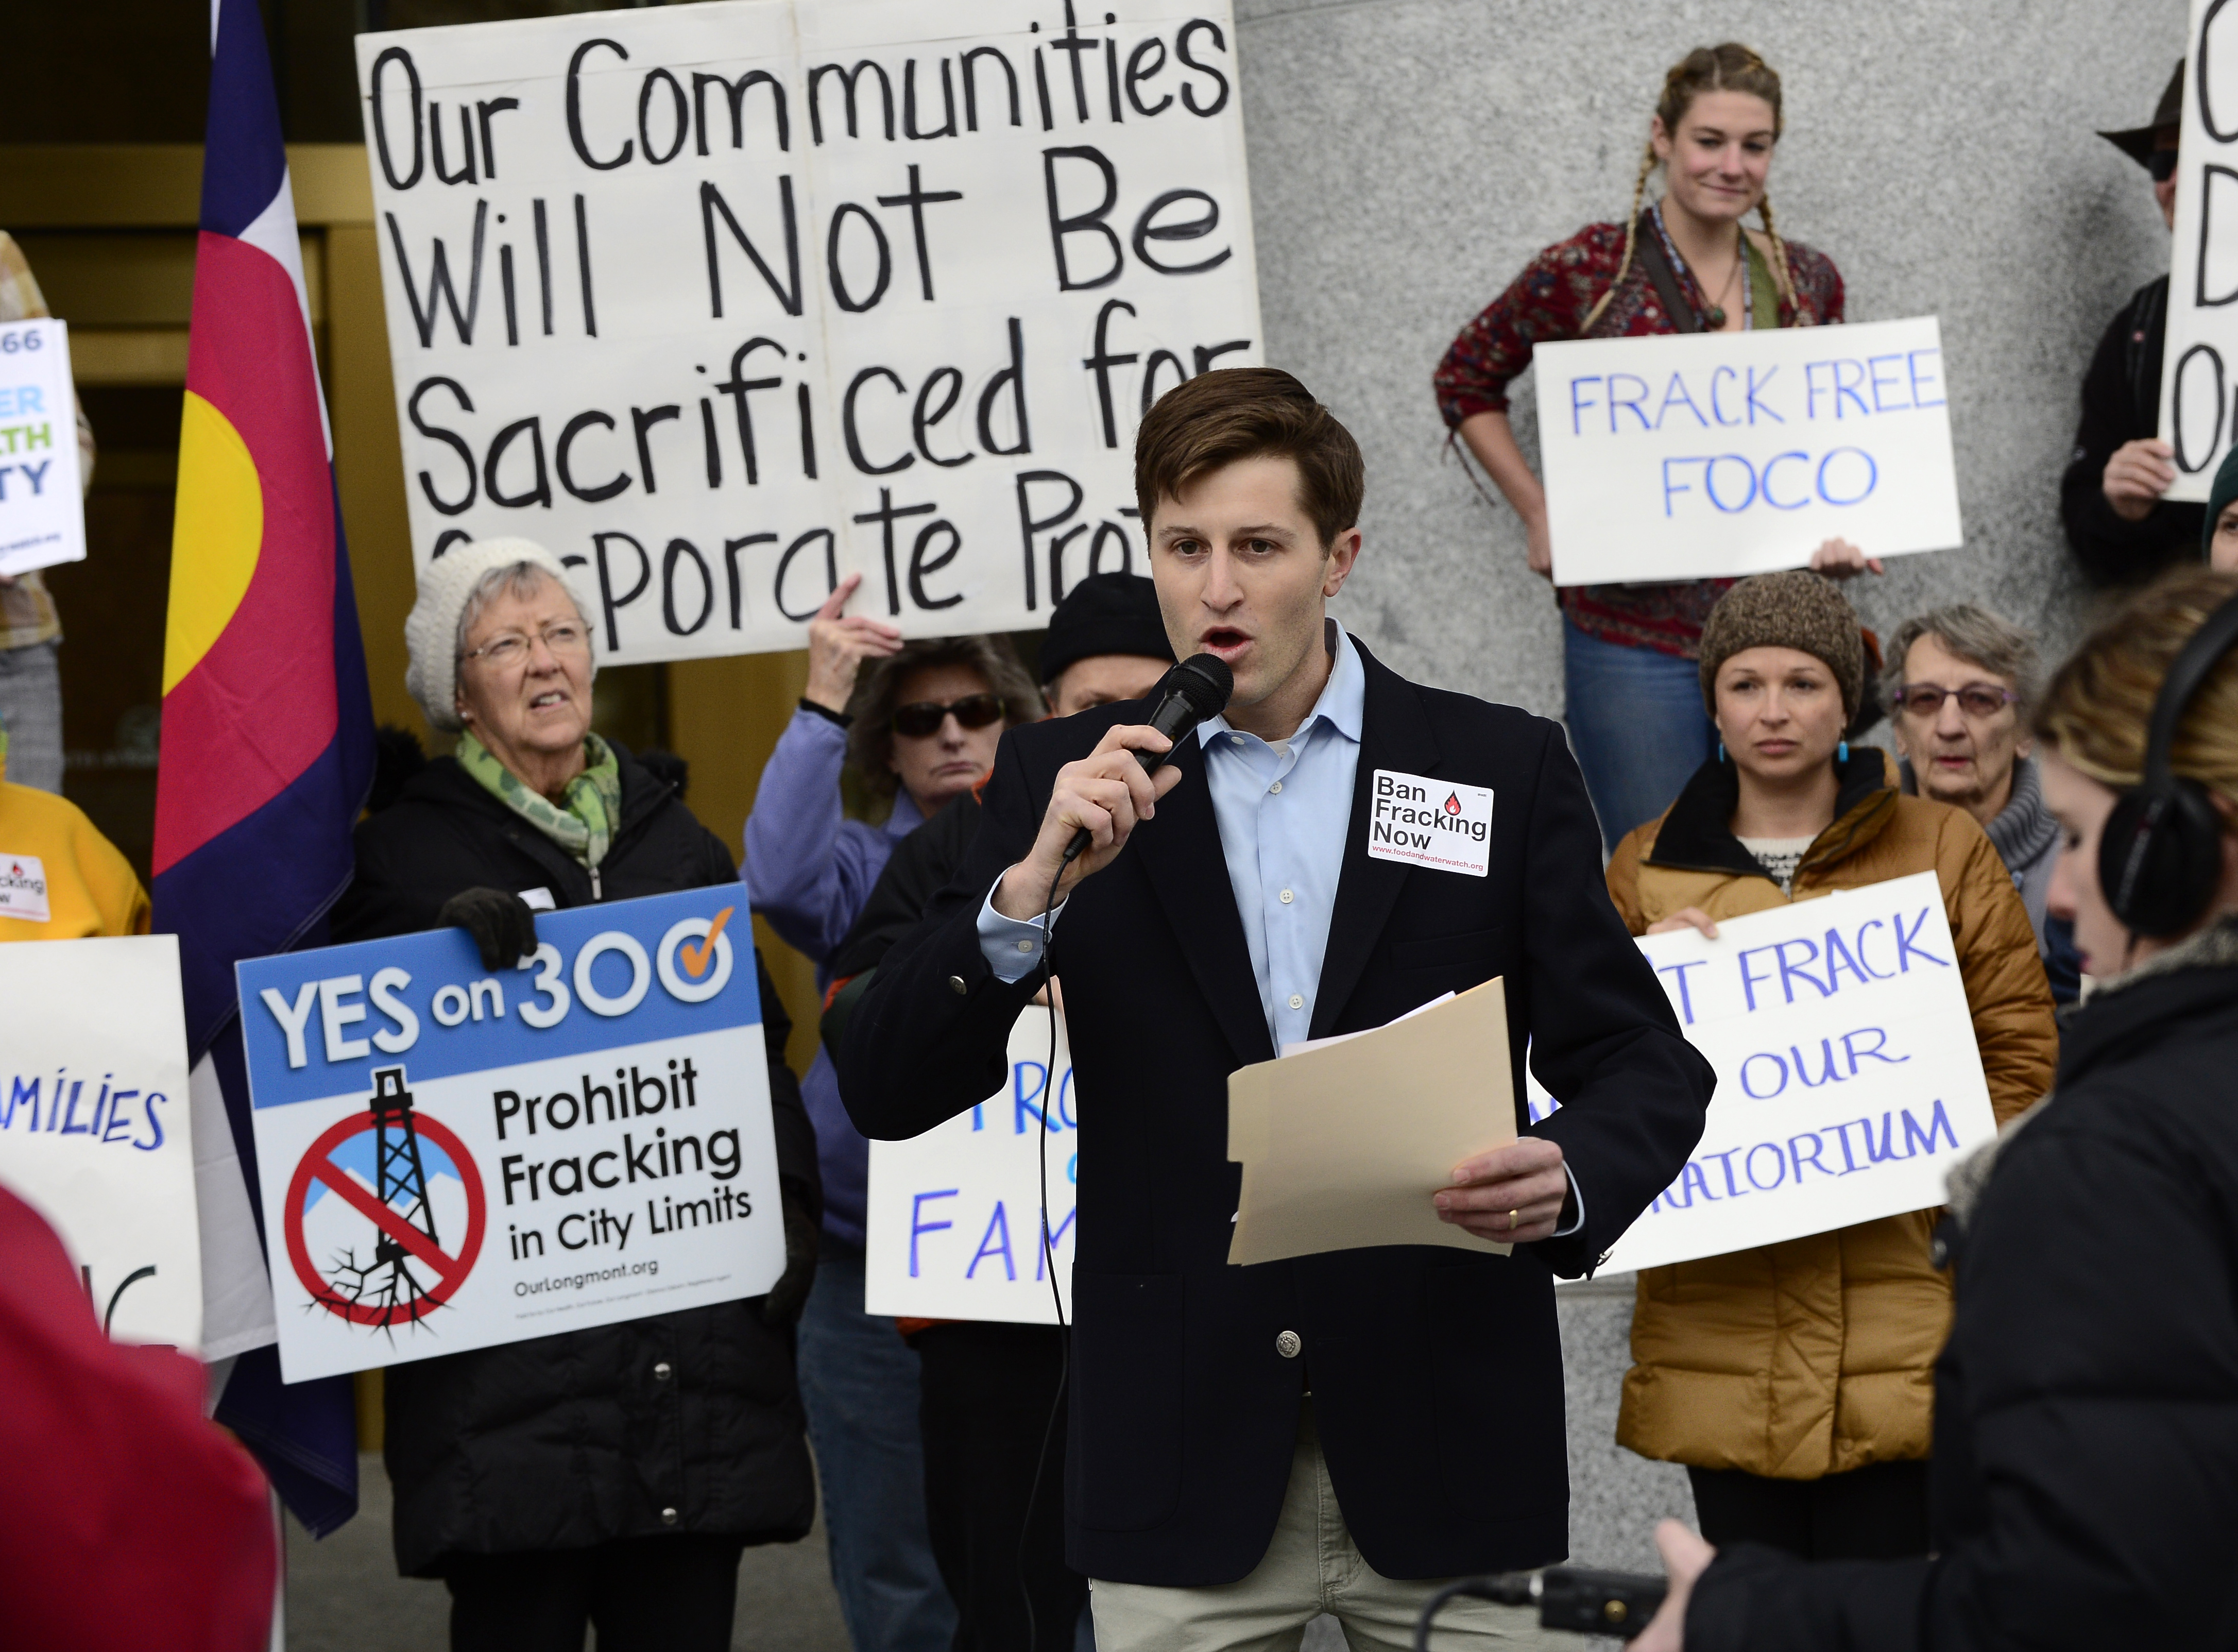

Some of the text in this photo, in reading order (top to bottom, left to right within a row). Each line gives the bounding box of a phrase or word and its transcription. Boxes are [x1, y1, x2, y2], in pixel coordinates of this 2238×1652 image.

[371, 0, 1229, 191] Our Communities
[385, 145, 1232, 348] Will Not Be
[408, 317, 1031, 515] Sacrificed
[1570, 347, 1947, 436] FRACK FREE
[0, 421, 52, 454] TH
[1662, 446, 1879, 517] FOCO
[432, 471, 1141, 652] porate Pro
[1376, 798, 1487, 841] Fracking
[1377, 776, 1426, 803] Ban
[1372, 846, 1483, 871] www.foodandwaterwatch.org
[1374, 821, 1431, 850] Now
[260, 917, 733, 1068] YES on 300
[1738, 906, 1951, 1011] FRACK
[493, 1057, 697, 1140] Prohibit
[1740, 1027, 1911, 1100] OUR
[501, 1128, 741, 1205] Fracking
[509, 1185, 751, 1260] in City Limits
[515, 1260, 658, 1297] OurLongmont.org
